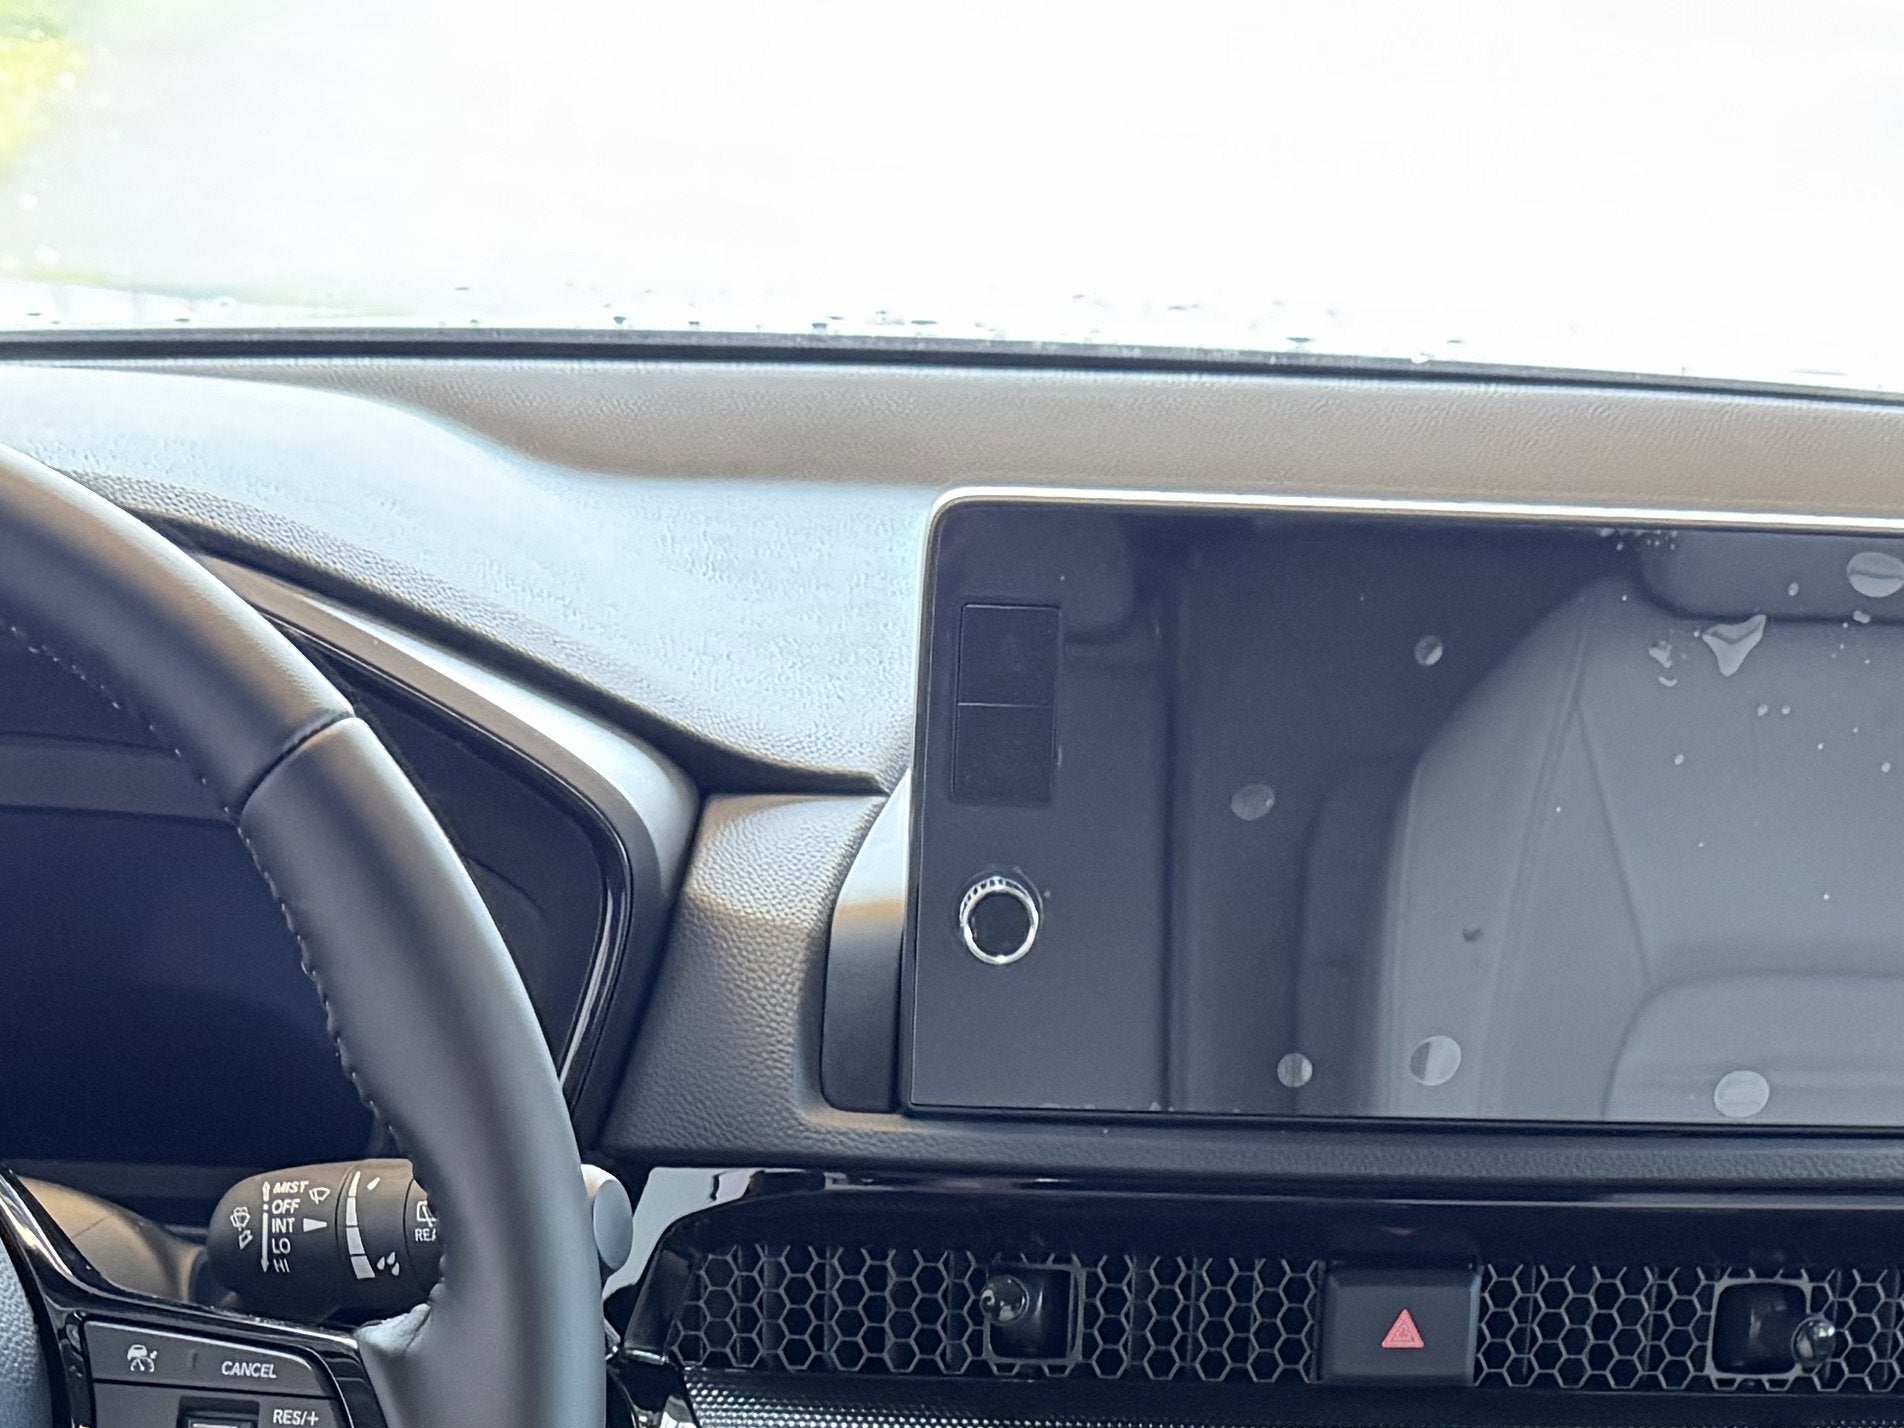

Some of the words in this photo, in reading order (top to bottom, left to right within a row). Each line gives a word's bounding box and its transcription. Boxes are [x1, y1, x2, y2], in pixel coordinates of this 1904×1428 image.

[273, 1180, 309, 1194] MIST
[271, 1199, 300, 1215] OFF
[271, 1218, 296, 1233] INT
[415, 1228, 438, 1242] REA
[271, 1238, 291, 1254] LO
[273, 1258, 290, 1274] HI
[221, 1360, 278, 1379] CANCEL
[273, 1408, 320, 1427] RES/+
